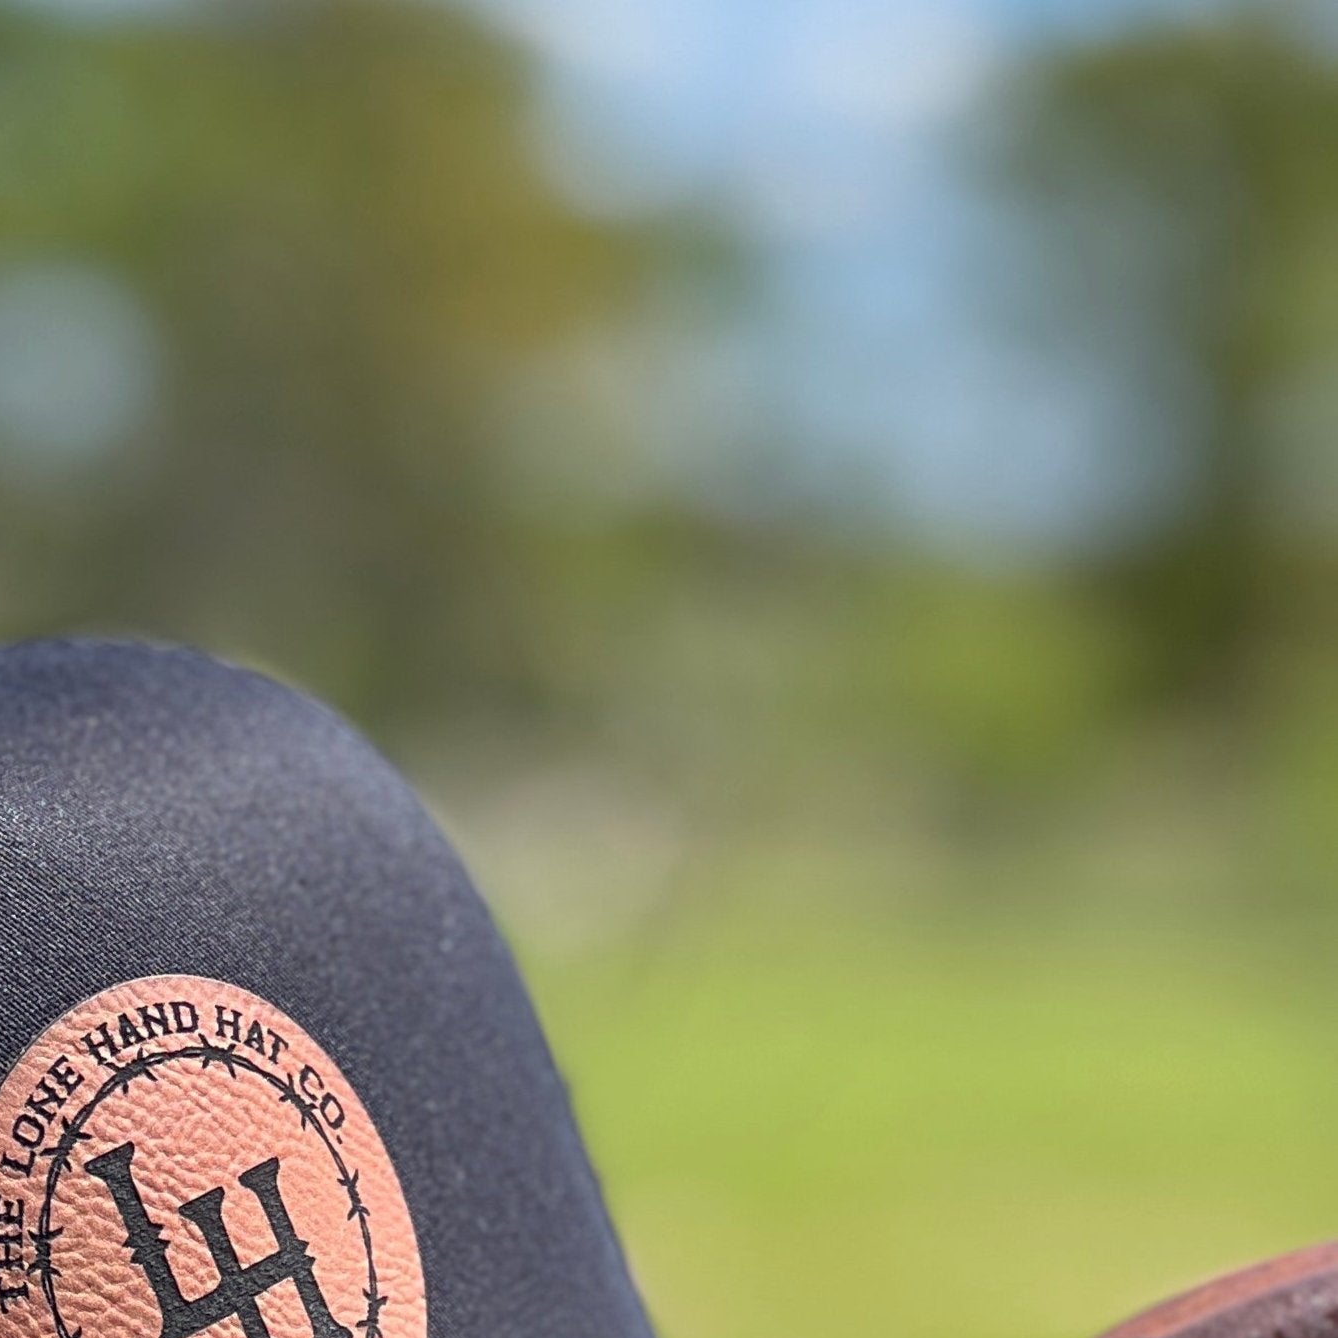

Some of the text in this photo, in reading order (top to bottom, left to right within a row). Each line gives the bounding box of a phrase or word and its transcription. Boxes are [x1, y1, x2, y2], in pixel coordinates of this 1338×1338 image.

[2, 1056, 85, 1177] LONE
[81, 1000, 200, 1065] HAND
[214, 1004, 289, 1065] HAT
